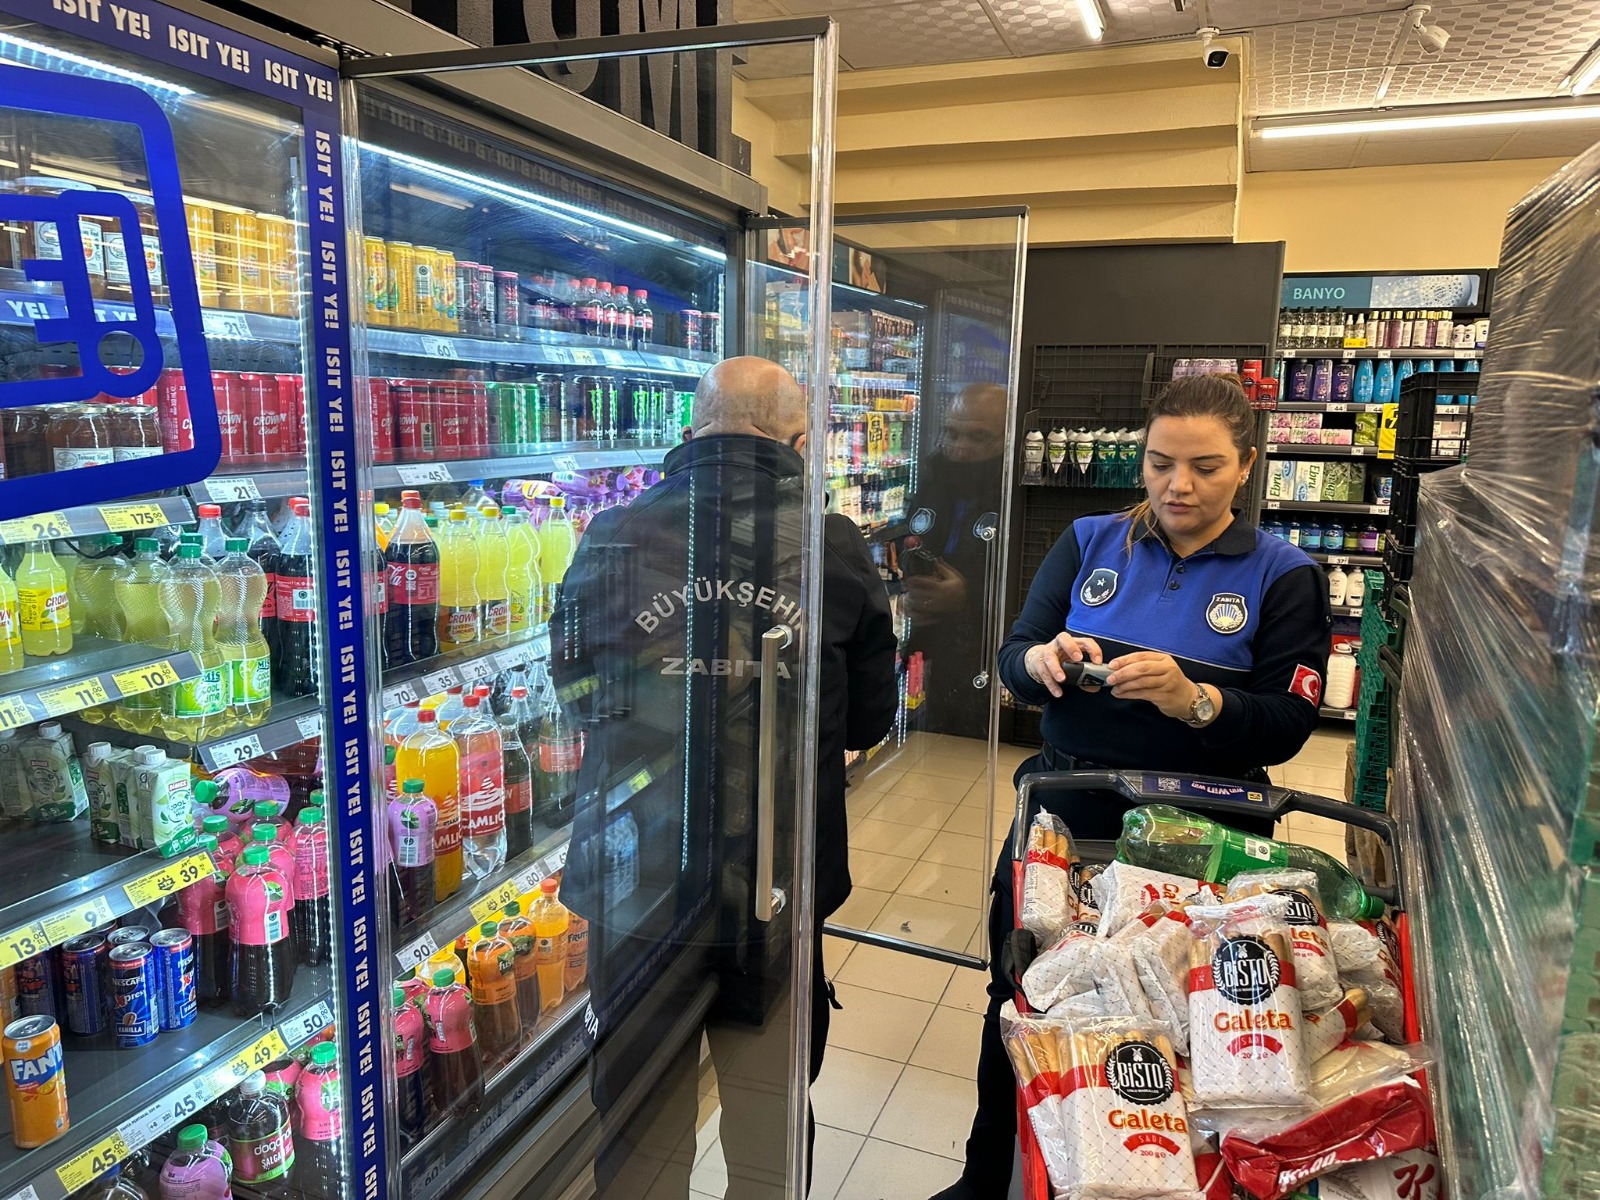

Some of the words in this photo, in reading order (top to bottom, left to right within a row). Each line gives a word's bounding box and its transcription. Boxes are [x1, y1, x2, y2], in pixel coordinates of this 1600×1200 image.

[110, 3, 151, 40] YE!
[168, 25, 209, 60] ISIT
[216, 42, 250, 74] YE!
[265, 60, 299, 90] ISIT
[305, 74, 333, 102] YE!
[316, 131, 332, 177] ISIT
[319, 186, 334, 222] YE!
[322, 241, 336, 285] ISIT
[324, 293, 338, 328] YE!
[1293, 287, 1345, 300] BANYO
[327, 348, 341, 388] ISIT
[329, 398, 343, 432] YE!
[332, 451, 346, 489] ISIT
[1269, 473, 1282, 497] Ebru
[1308, 464, 1320, 489] Ebru
[334, 498, 348, 532] YE!
[337, 550, 350, 588] ISIT
[339, 596, 352, 629] YE!
[341, 646, 355, 682] ISIT
[344, 690, 357, 724] YE!
[394, 690, 411, 704] 70
[346, 738, 359, 775] ISIT
[348, 782, 361, 815] YE!
[350, 829, 363, 865] ISIT
[352, 871, 365, 905] YE!
[1286, 900, 1313, 919] STO
[354, 916, 367, 953] ISIT
[413, 944, 430, 962] 90
[356, 957, 369, 989] YE!
[358, 1002, 371, 1038] ISIT
[1213, 1009, 1294, 1033] Galeta
[360, 1041, 372, 1075] YE!
[362, 1084, 374, 1121] ISIT
[1107, 1109, 1188, 1134] Galeta
[364, 1123, 375, 1157] YE!
[1138, 1134, 1164, 1144] SADE
